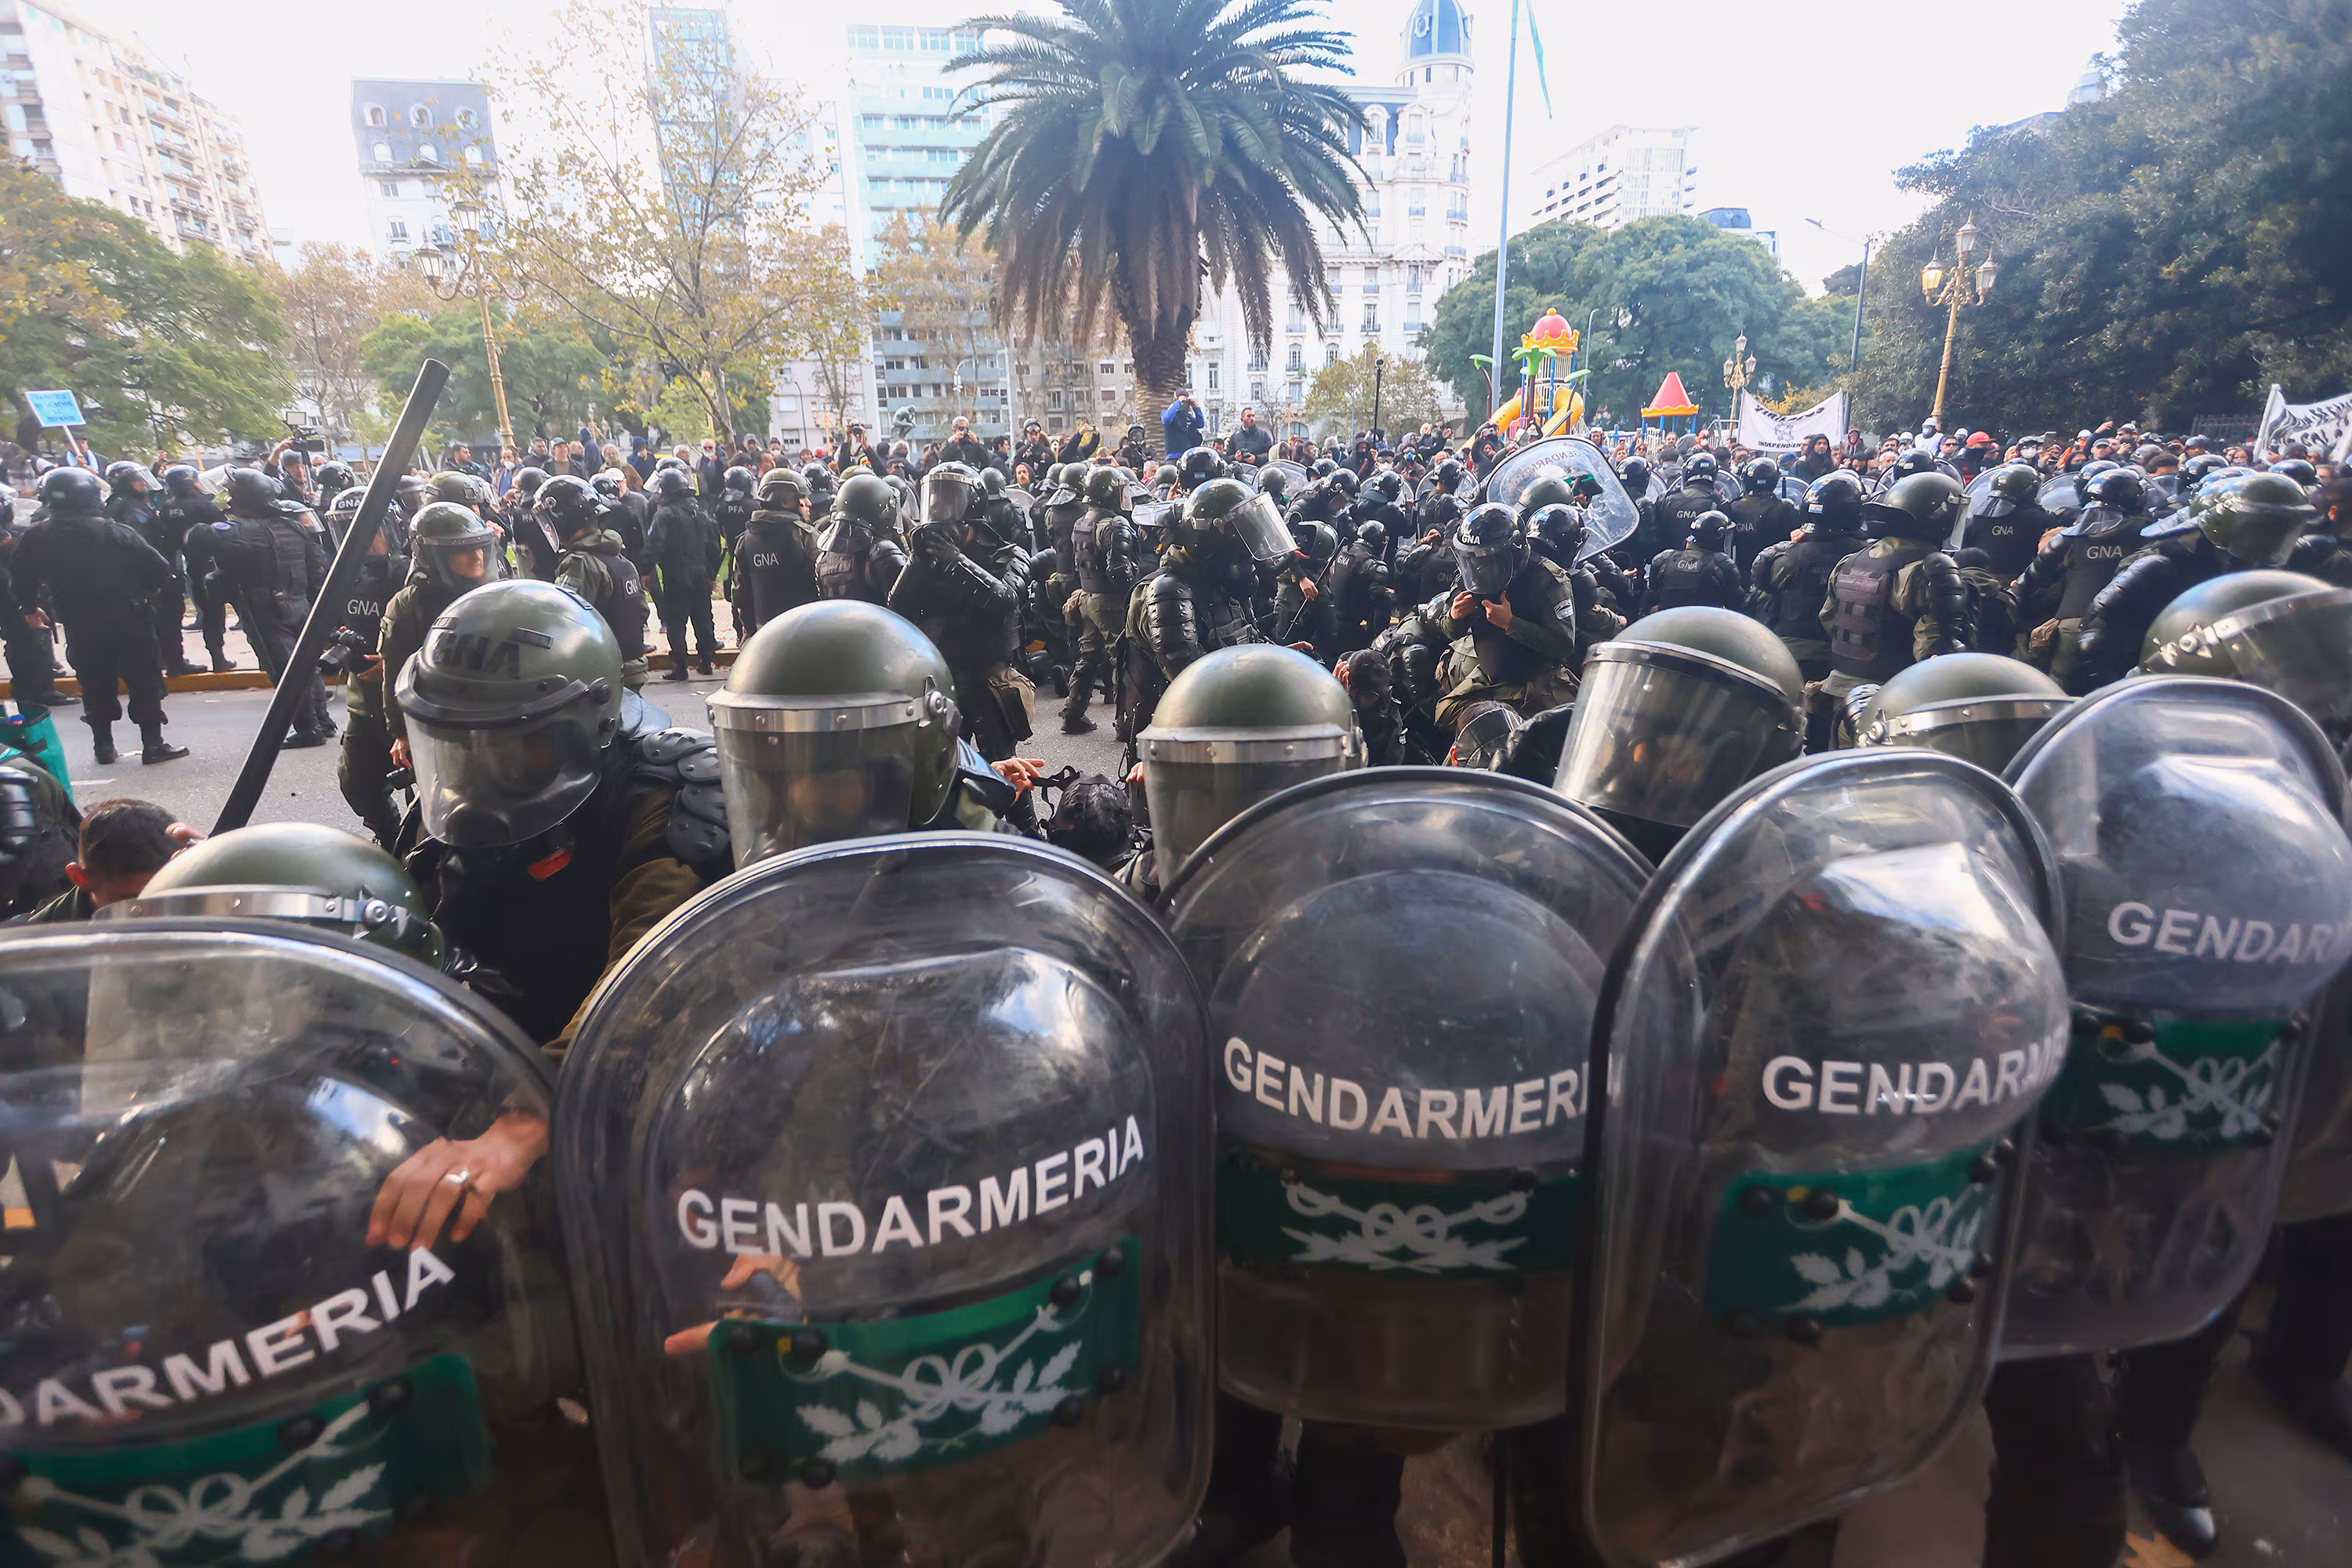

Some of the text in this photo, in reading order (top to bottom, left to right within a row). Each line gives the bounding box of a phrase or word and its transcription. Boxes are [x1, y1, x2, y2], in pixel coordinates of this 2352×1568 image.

[1759, 441, 1802, 449] INDEPENDiEN
[338, 499, 361, 509] GNA
[728, 505, 745, 514] PFA
[1736, 522, 1755, 532] GNA
[1992, 525, 2013, 535] GNA
[1461, 534, 1481, 545] GNA
[2086, 546, 2122, 559] GNA
[753, 553, 779, 567] GNA
[1337, 555, 1350, 567] GNA
[1678, 560, 1698, 570] GNA
[347, 599, 380, 617] GNA
[1224, 1036, 1589, 1140] GENDARMERI
[677, 1114, 1145, 1259] GENDARMERIA
